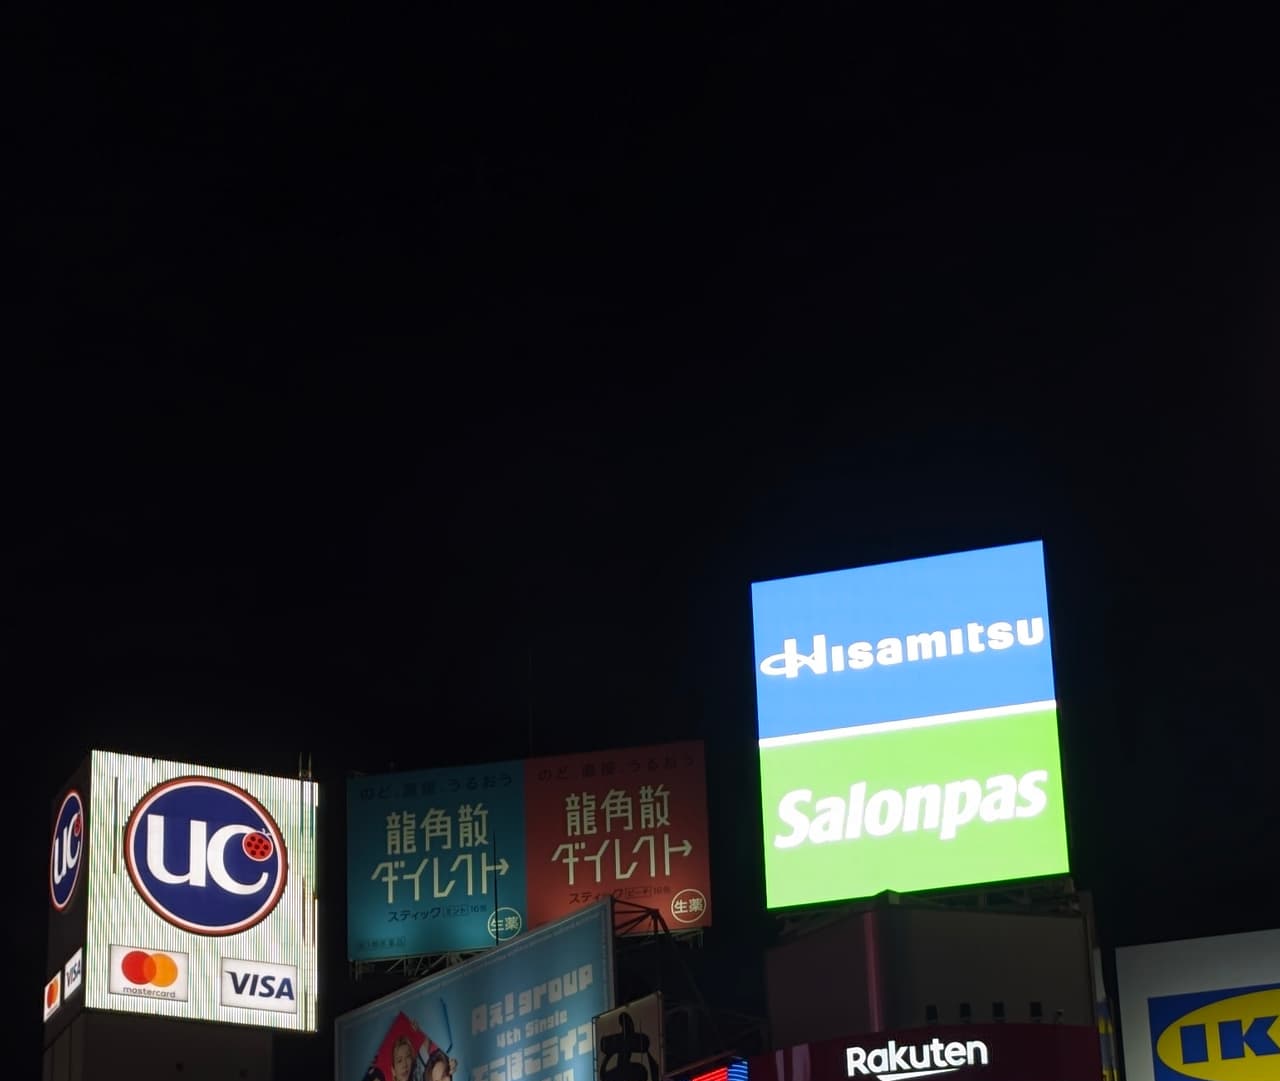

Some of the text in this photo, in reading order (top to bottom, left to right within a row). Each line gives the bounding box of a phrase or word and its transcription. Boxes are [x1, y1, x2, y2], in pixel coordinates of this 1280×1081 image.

[760, 616, 1045, 679] Hisamitsu
[387, 803, 489, 856] 龍角散
[565, 784, 671, 837] 龍角散
[773, 769, 1049, 850] Salonpas
[54, 812, 81, 886] UC
[147, 814, 269, 896] UC
[551, 833, 693, 886] ダイレクト
[371, 852, 510, 904] ダイレクト
[388, 907, 441, 923] スティック
[673, 898, 705, 914] 生薬
[123, 986, 177, 999] mastercard
[225, 970, 295, 1001] VISA
[846, 1038, 990, 1077] Rakuten
